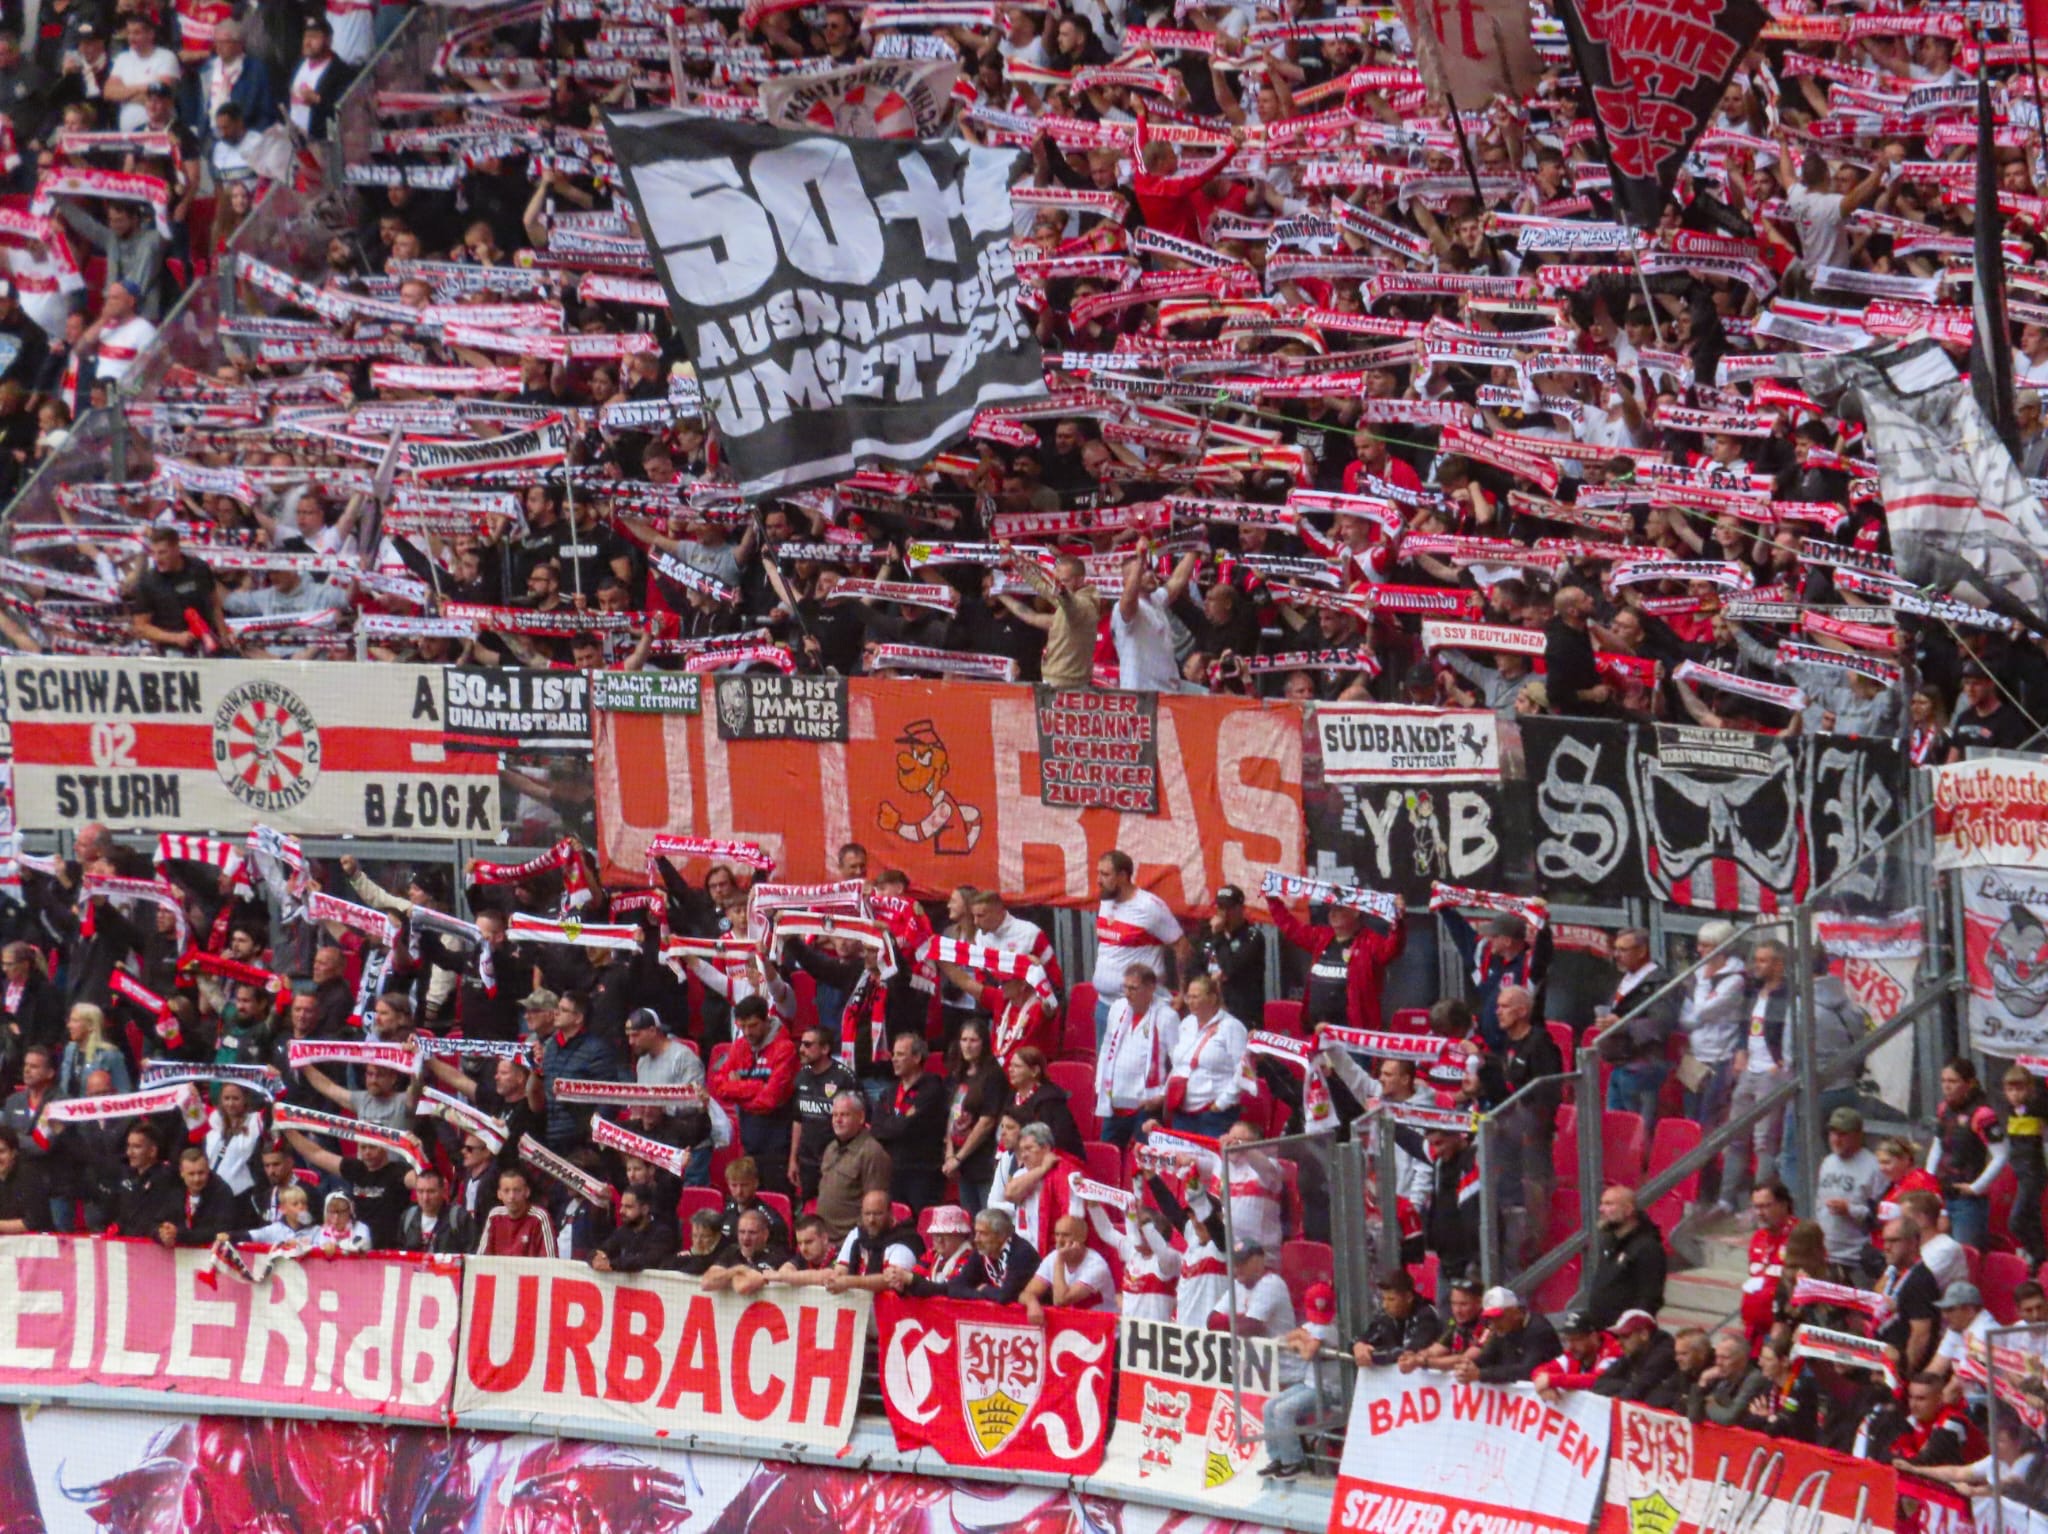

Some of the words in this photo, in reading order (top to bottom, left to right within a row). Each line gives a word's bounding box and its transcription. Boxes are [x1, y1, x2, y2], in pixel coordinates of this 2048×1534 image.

[1444, 627, 1466, 639] SSV
[1471, 629, 1544, 647] REUTLINGEN
[16, 669, 202, 714] SCHWABEN
[412, 676, 438, 720] A
[533, 676, 586, 710] IST
[608, 675, 653, 694] MAGIC
[660, 676, 697, 694] FANS
[753, 677, 782, 696] DU
[792, 678, 838, 699] BIST
[608, 695, 635, 707] POUR
[753, 698, 838, 720] IMMER
[1052, 691, 1138, 714] JEDER
[449, 707, 587, 731] UNANTASTBAR!
[754, 719, 784, 735] BEI
[795, 719, 838, 738] UNS!
[1040, 709, 1151, 741] VERBANNTE
[1325, 717, 1455, 752] SÜDBANDE
[91, 723, 137, 767] 02
[1053, 739, 1142, 763] KEHRT
[1392, 754, 1457, 768] STUTTGART
[57, 774, 181, 818] STURM
[366, 782, 490, 829] BLOCK
[467, 1274, 856, 1428] URBACH
[1128, 1320, 1273, 1393] HESSEN
[1368, 1385, 1442, 1436] BAD
[1451, 1384, 1600, 1478] WIMPFEN
